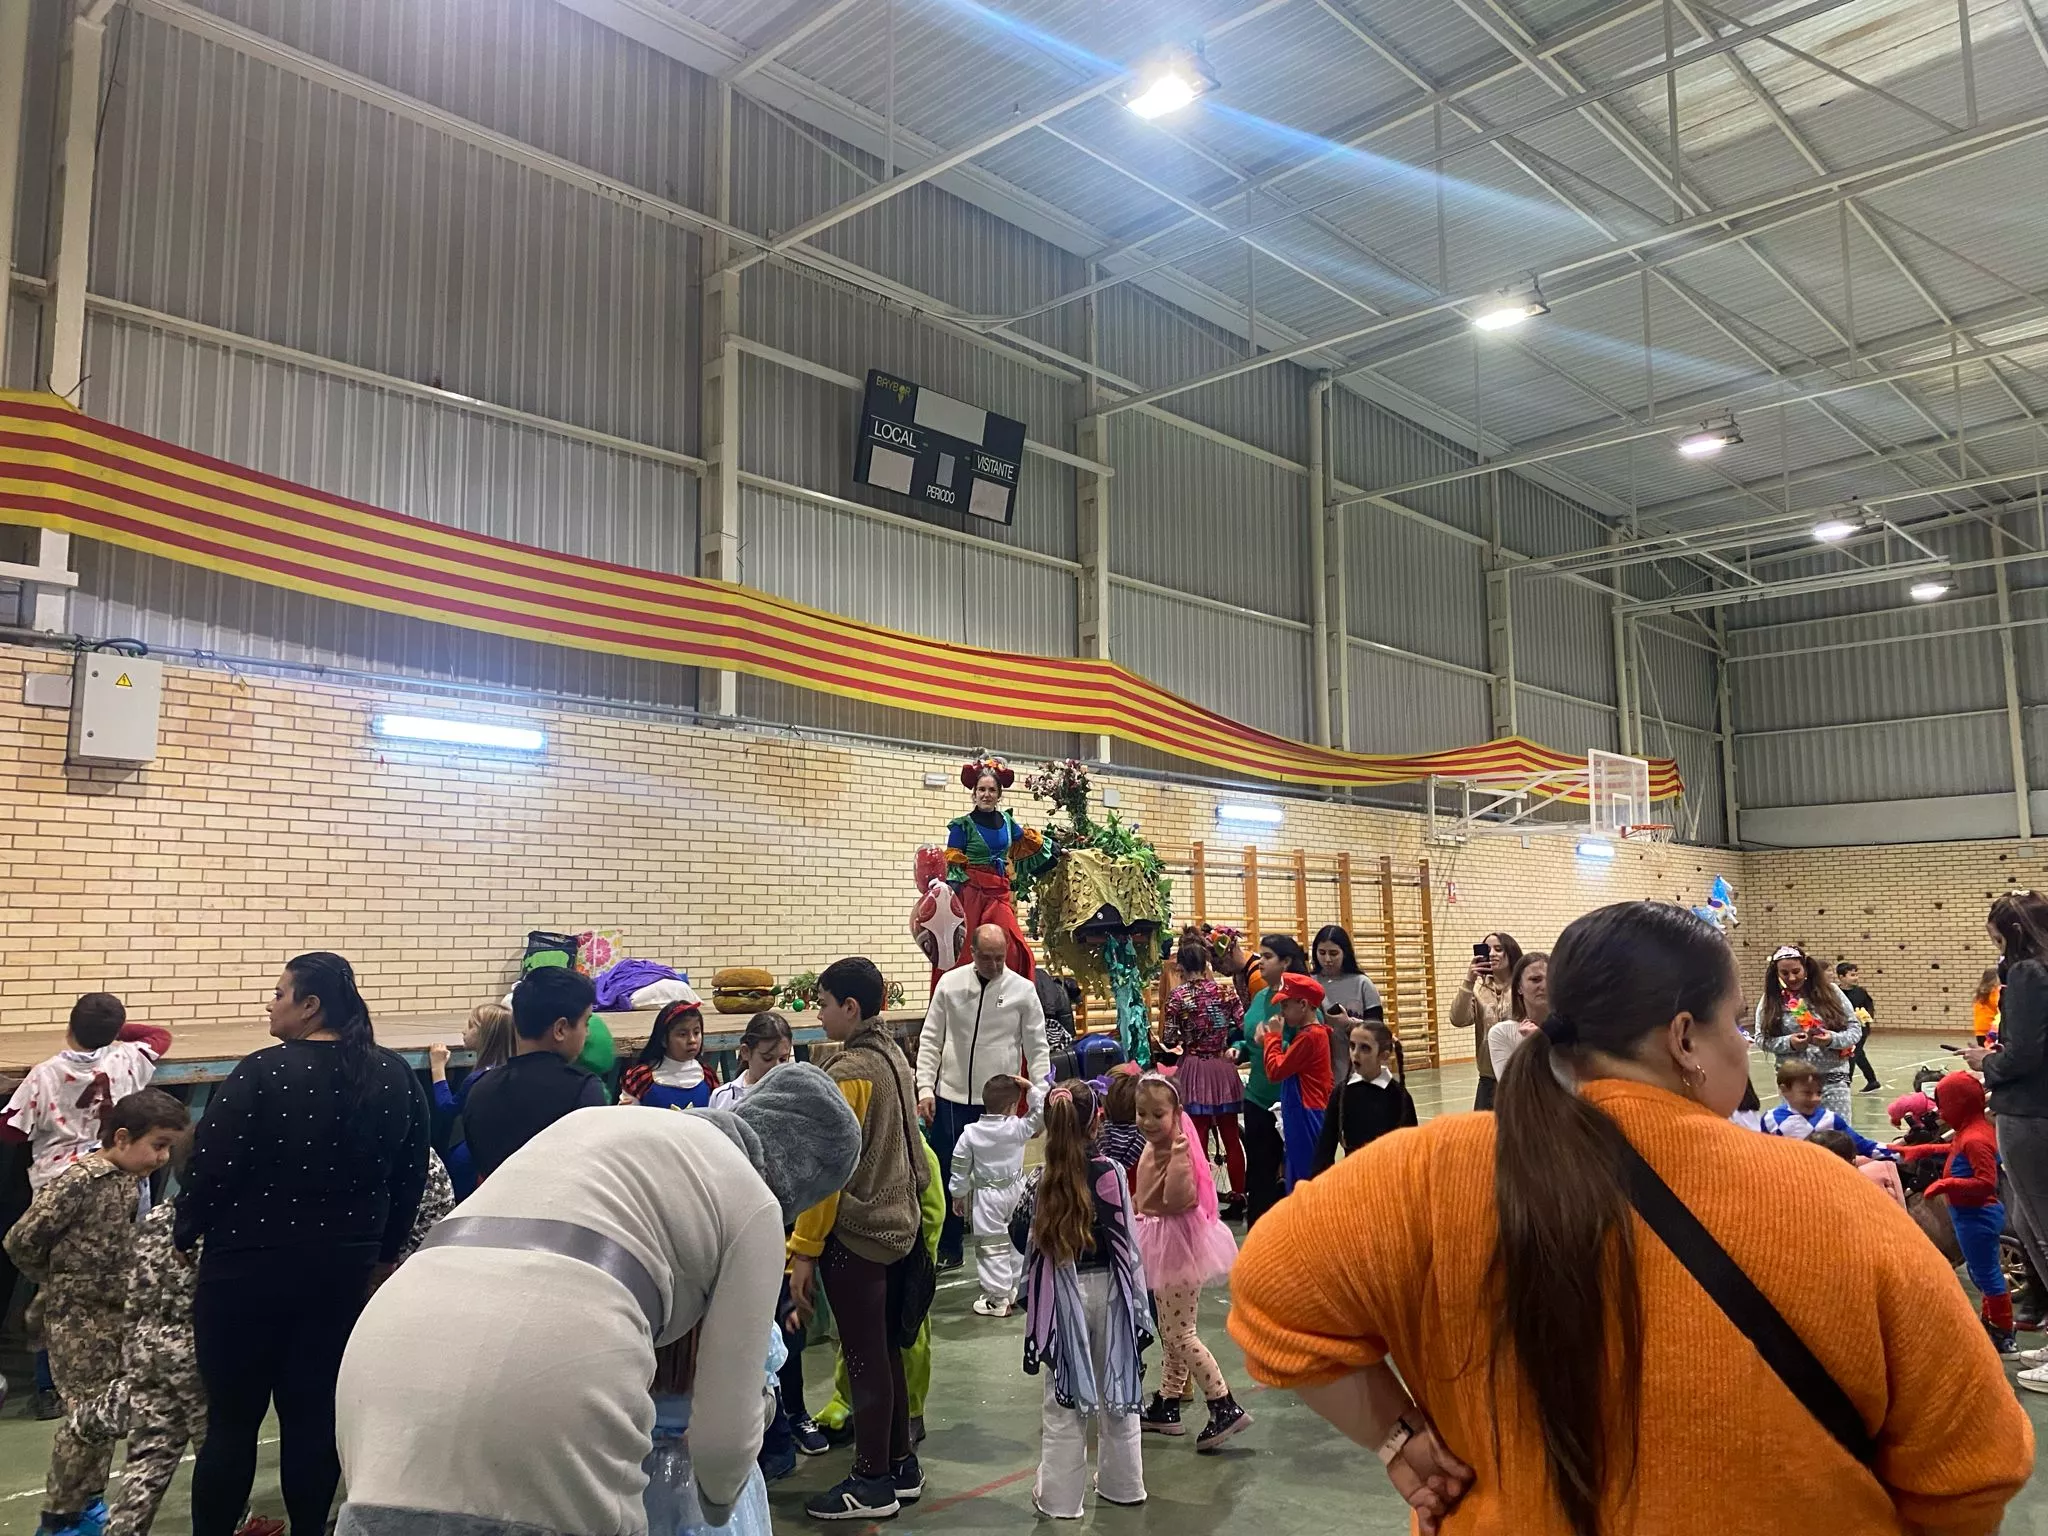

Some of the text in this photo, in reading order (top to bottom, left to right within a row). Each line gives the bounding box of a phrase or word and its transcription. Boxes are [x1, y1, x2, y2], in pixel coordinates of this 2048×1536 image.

[874, 420, 917, 448] LOCAL
[977, 455, 1015, 480] VISITANTE
[926, 484, 955, 504] PERIODO
